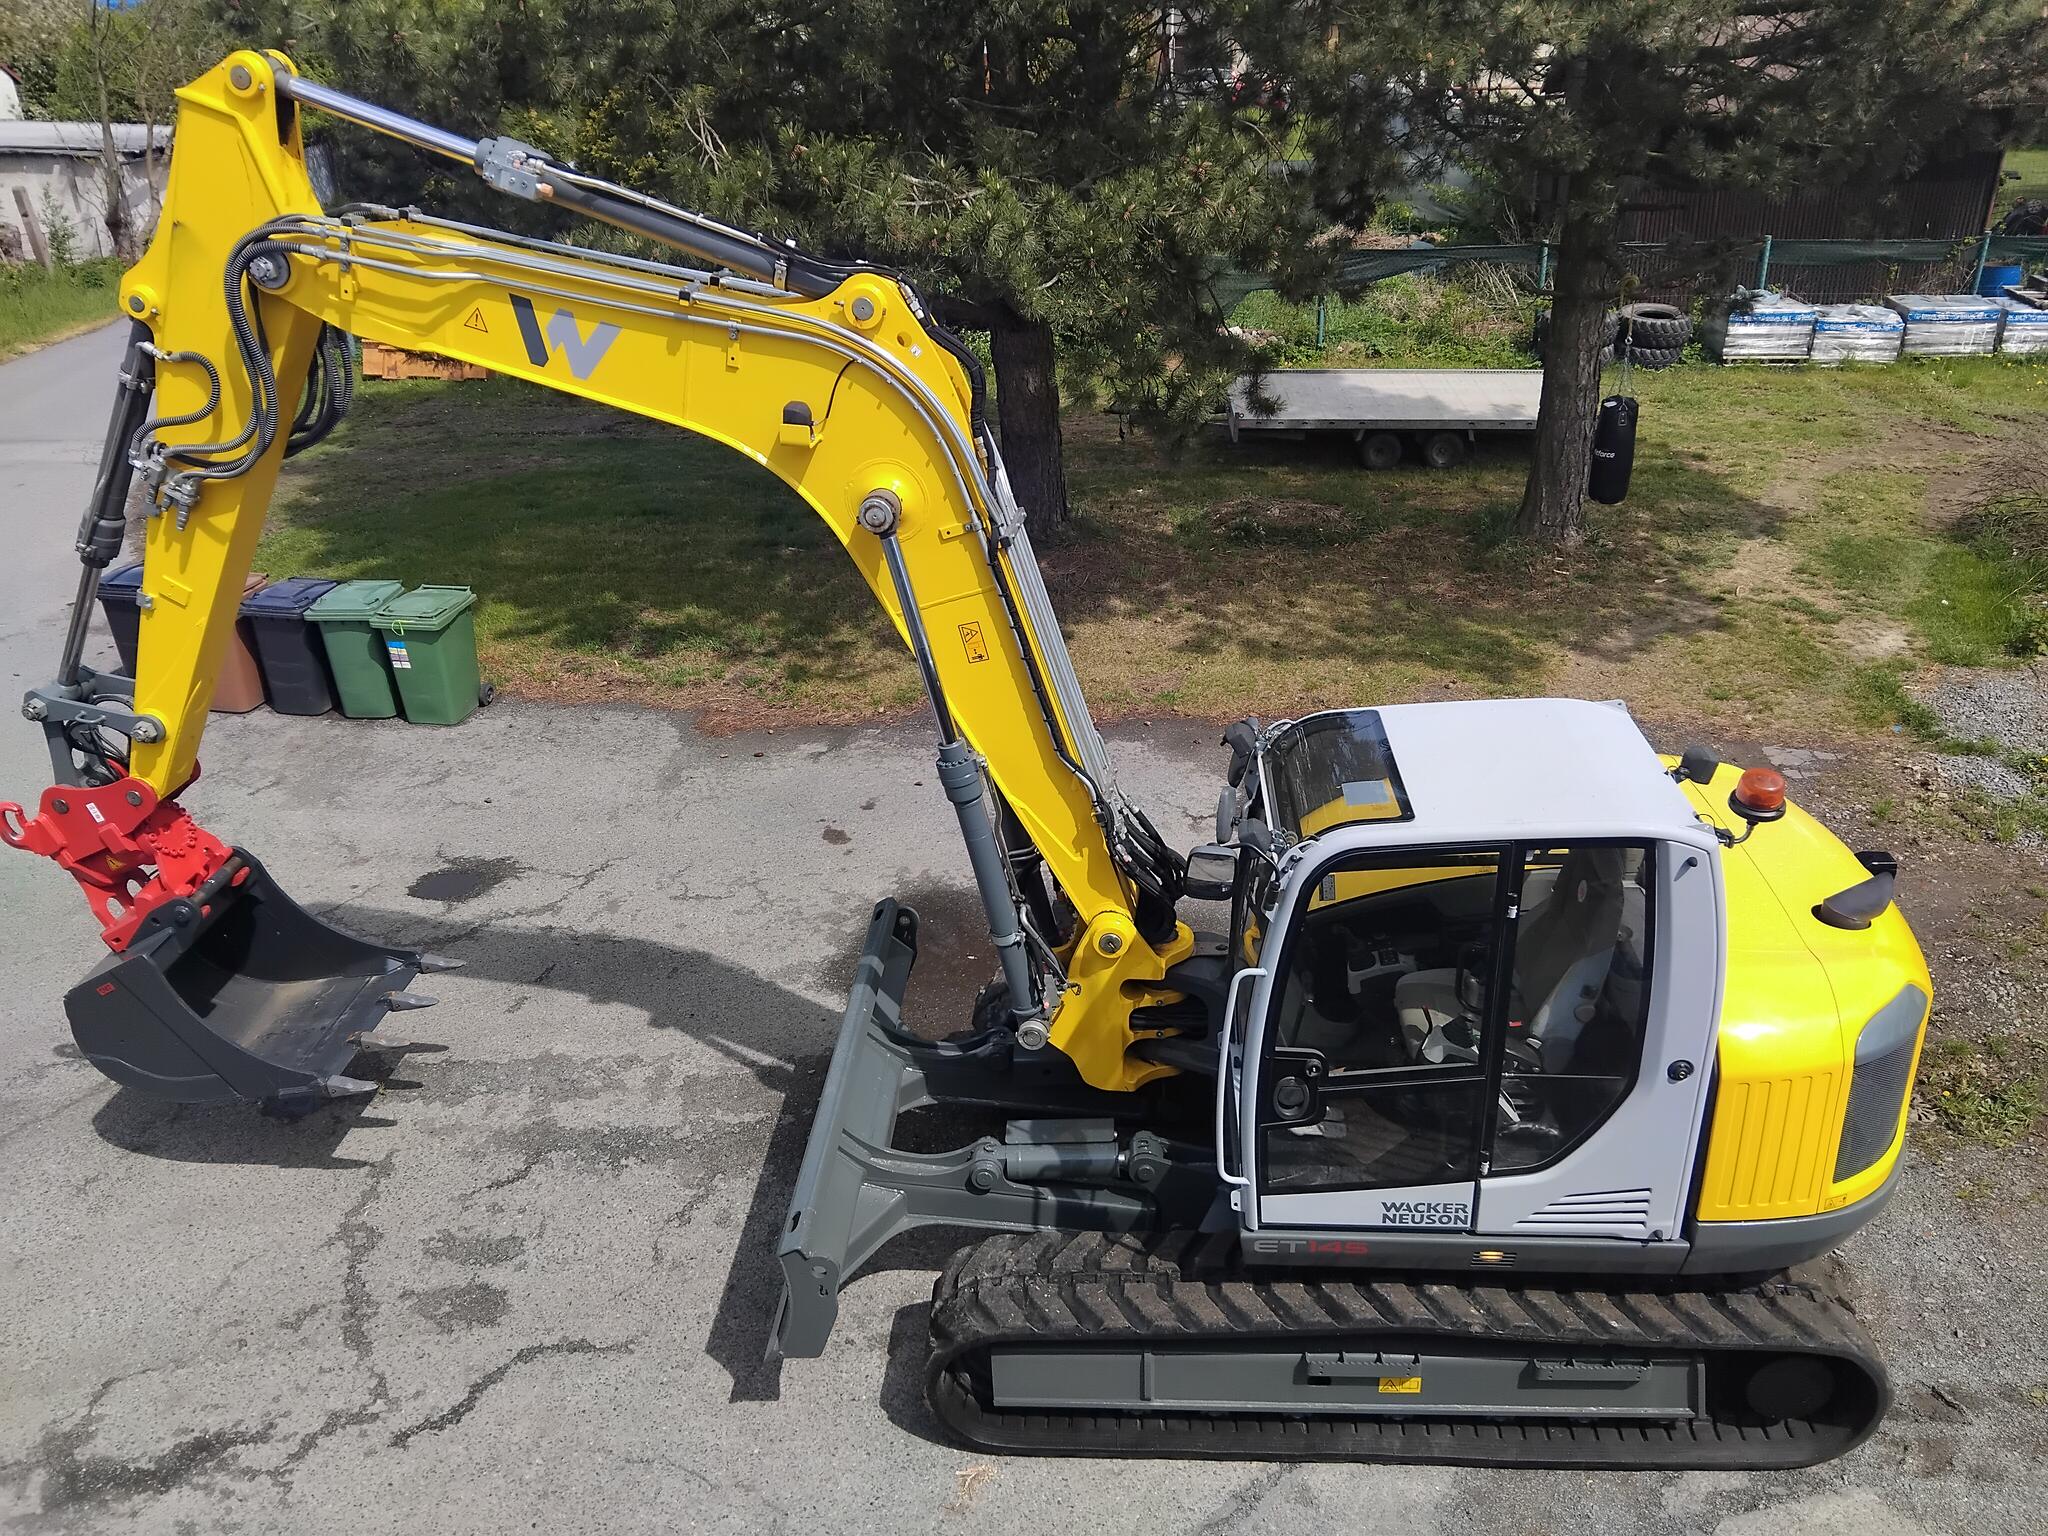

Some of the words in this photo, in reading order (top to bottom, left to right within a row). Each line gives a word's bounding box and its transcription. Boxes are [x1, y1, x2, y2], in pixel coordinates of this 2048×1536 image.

[1381, 1202, 1469, 1214] WACKER
[1382, 1213, 1468, 1225] NEUSON
[1254, 1239, 1368, 1254] ET145
